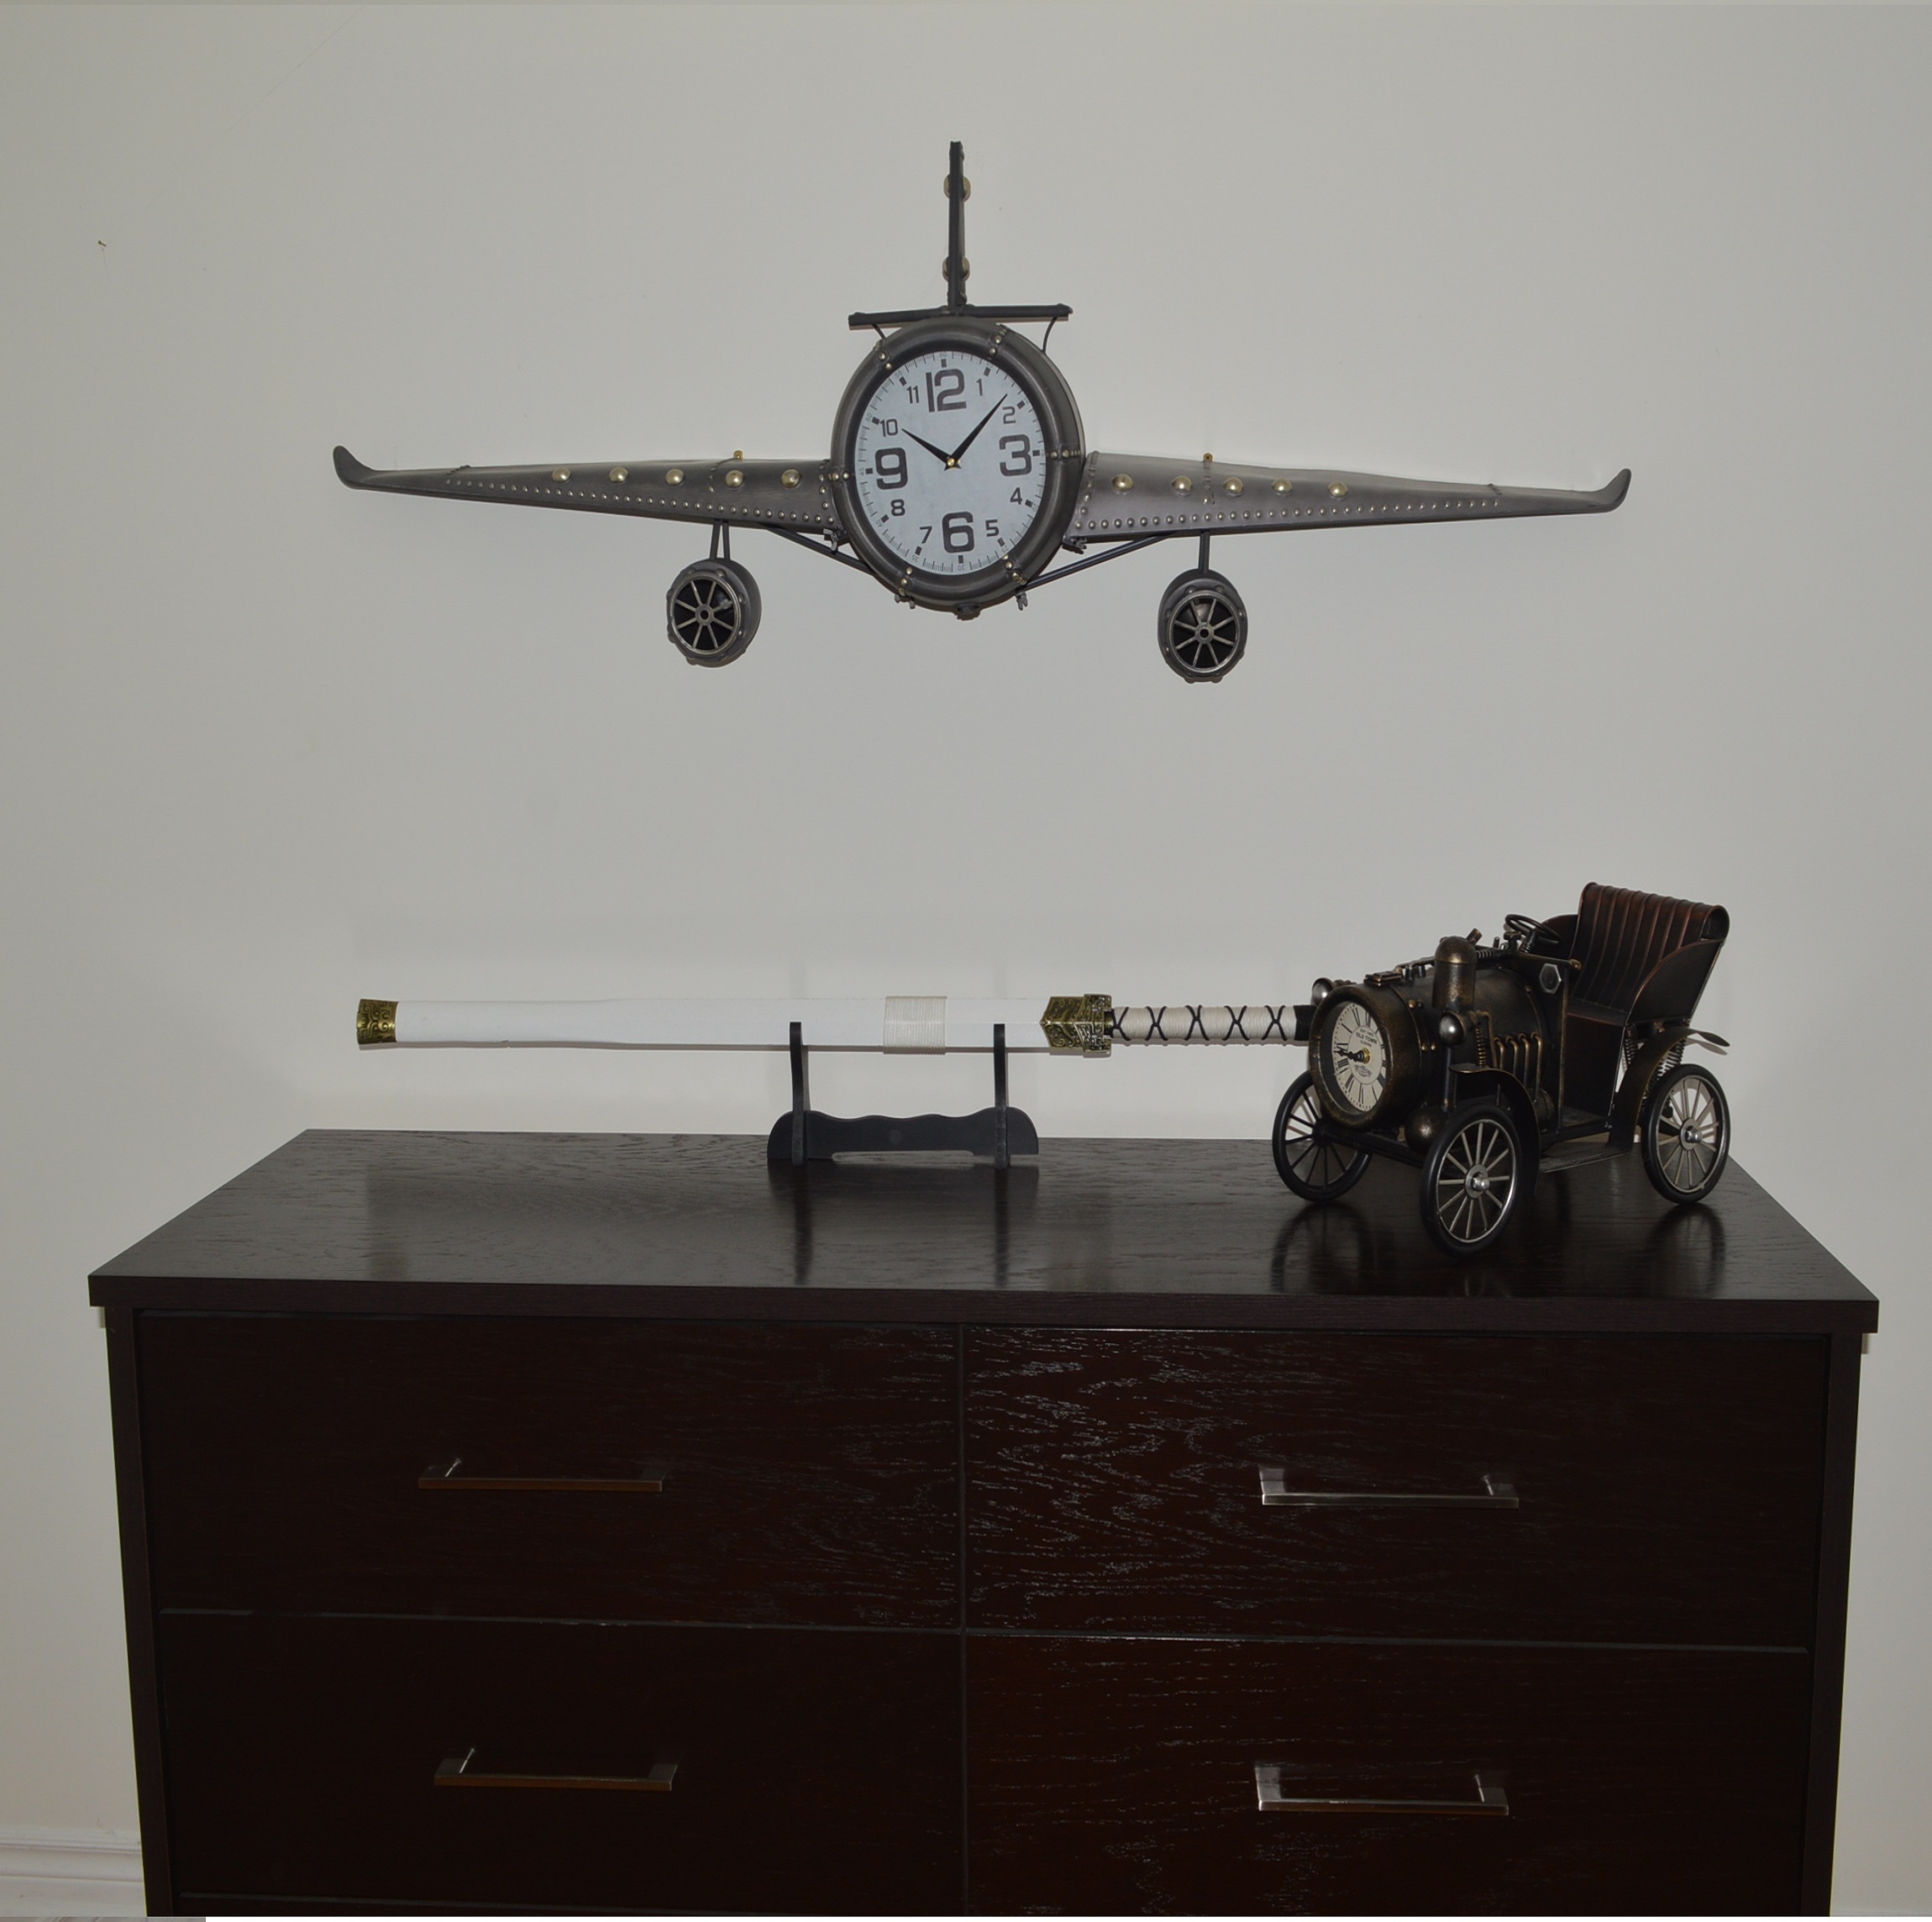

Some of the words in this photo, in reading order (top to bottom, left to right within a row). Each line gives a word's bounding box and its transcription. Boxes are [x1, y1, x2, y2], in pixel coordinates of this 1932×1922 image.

[906, 386, 920, 404] 11
[926, 368, 967, 412] 12
[976, 378, 983, 396] 1
[1002, 406, 1016, 424] 2
[879, 418, 898, 437] 10
[999, 434, 1032, 476] 3
[874, 447, 908, 490] 9
[1010, 487, 1023, 505] 4
[890, 498, 906, 517] 8
[919, 526, 932, 544] 7
[942, 511, 974, 554] 6
[985, 519, 1000, 537] 5
[1365, 1035, 1378, 1044] TOWN
